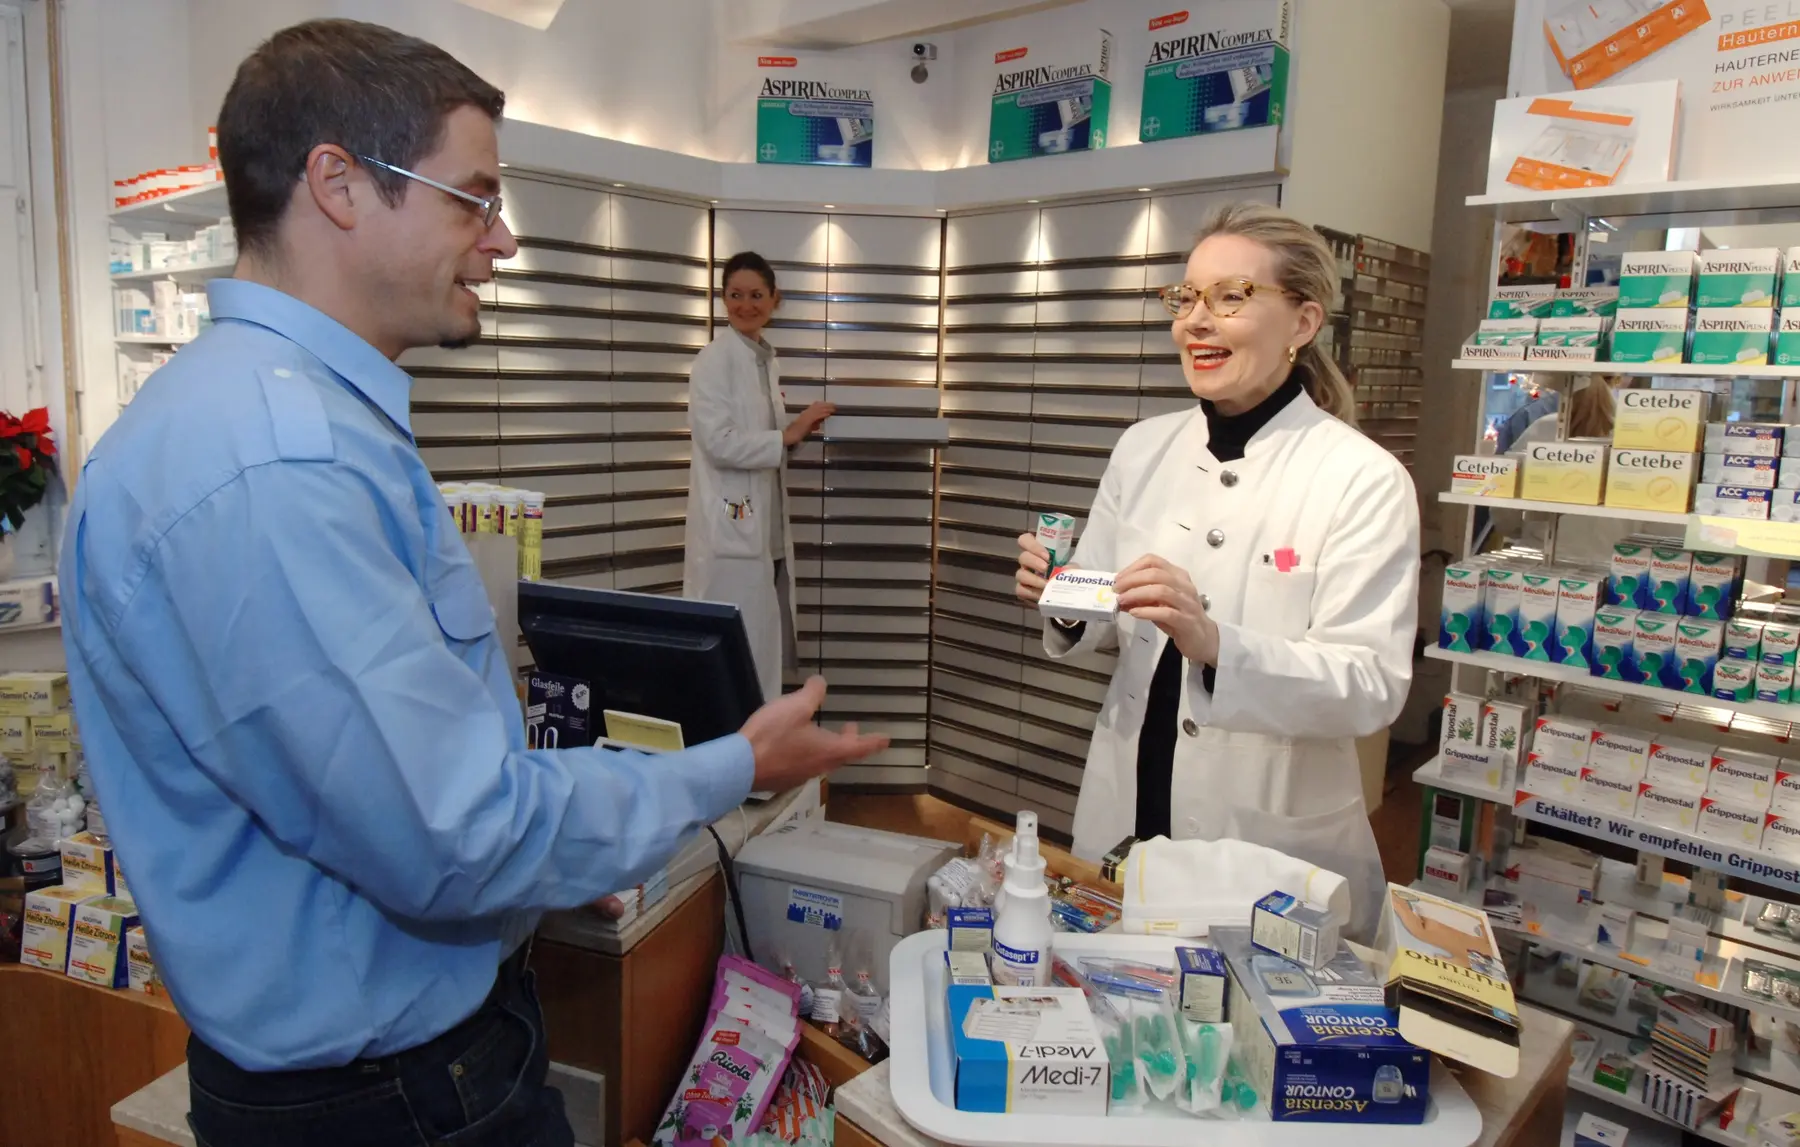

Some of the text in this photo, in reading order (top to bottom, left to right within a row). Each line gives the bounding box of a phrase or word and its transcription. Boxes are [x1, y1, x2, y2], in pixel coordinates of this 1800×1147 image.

[1722, 24, 1798, 47] Hautern
[1148, 28, 1273, 63] ASPIRIN COMPLEX
[994, 65, 1051, 93] ASPIRIN
[1052, 64, 1092, 80] COMPLEX
[1712, 78, 1744, 94] ZUR
[760, 77, 871, 100] ASPIRIN COMPLEX
[1710, 91, 1800, 112] WIRKSAMKEIT UNTE
[1623, 264, 1668, 274] ASPIRIN
[1703, 262, 1750, 274] ASPIRIN
[1496, 291, 1531, 300] ASPIRIN
[1560, 290, 1596, 298] ASPIRIN
[1617, 319, 1662, 330] ASPIRIN
[1698, 320, 1746, 331] ASPIRIN
[1463, 347, 1499, 358] ASPIRIN
[1529, 348, 1568, 359] ASPIRIN
[1624, 392, 1692, 410] Cetebe
[1728, 426, 1752, 435] ACC
[1532, 446, 1596, 464] Cetebe
[1616, 452, 1683, 470] Cetebe
[1726, 456, 1751, 465] ACC
[1457, 459, 1509, 476] Cetebe
[1719, 488, 1743, 496] ACC
[532, 678, 565, 692] Glasfeile
[1447, 704, 1457, 739] ippostad
[1487, 712, 1498, 748] ippostad
[1540, 725, 1586, 742] Grippostad
[1596, 737, 1644, 755] Grippostad
[1444, 748, 1489, 764] Grippostad
[1655, 751, 1705, 768] Grippostad
[1532, 760, 1577, 777] Grippostad
[1717, 764, 1769, 782] Grippostad
[1584, 774, 1632, 792] Grippostad
[1644, 790, 1694, 809] Grippostad
[1706, 805, 1759, 825] Grippostad
[1536, 801, 1800, 885] Erkältet? Wir empfehlen Grippost
[1405, 949, 1507, 992] FUTURO
[1306, 1015, 1388, 1028] CONTOUR
[1020, 1046, 1096, 1059] Medi-7
[710, 1051, 752, 1080] Ricola
[1020, 1065, 1102, 1086] Medi-7
[1286, 1085, 1356, 1100] CONTOUR
[1286, 1098, 1370, 1113] Ascensia
